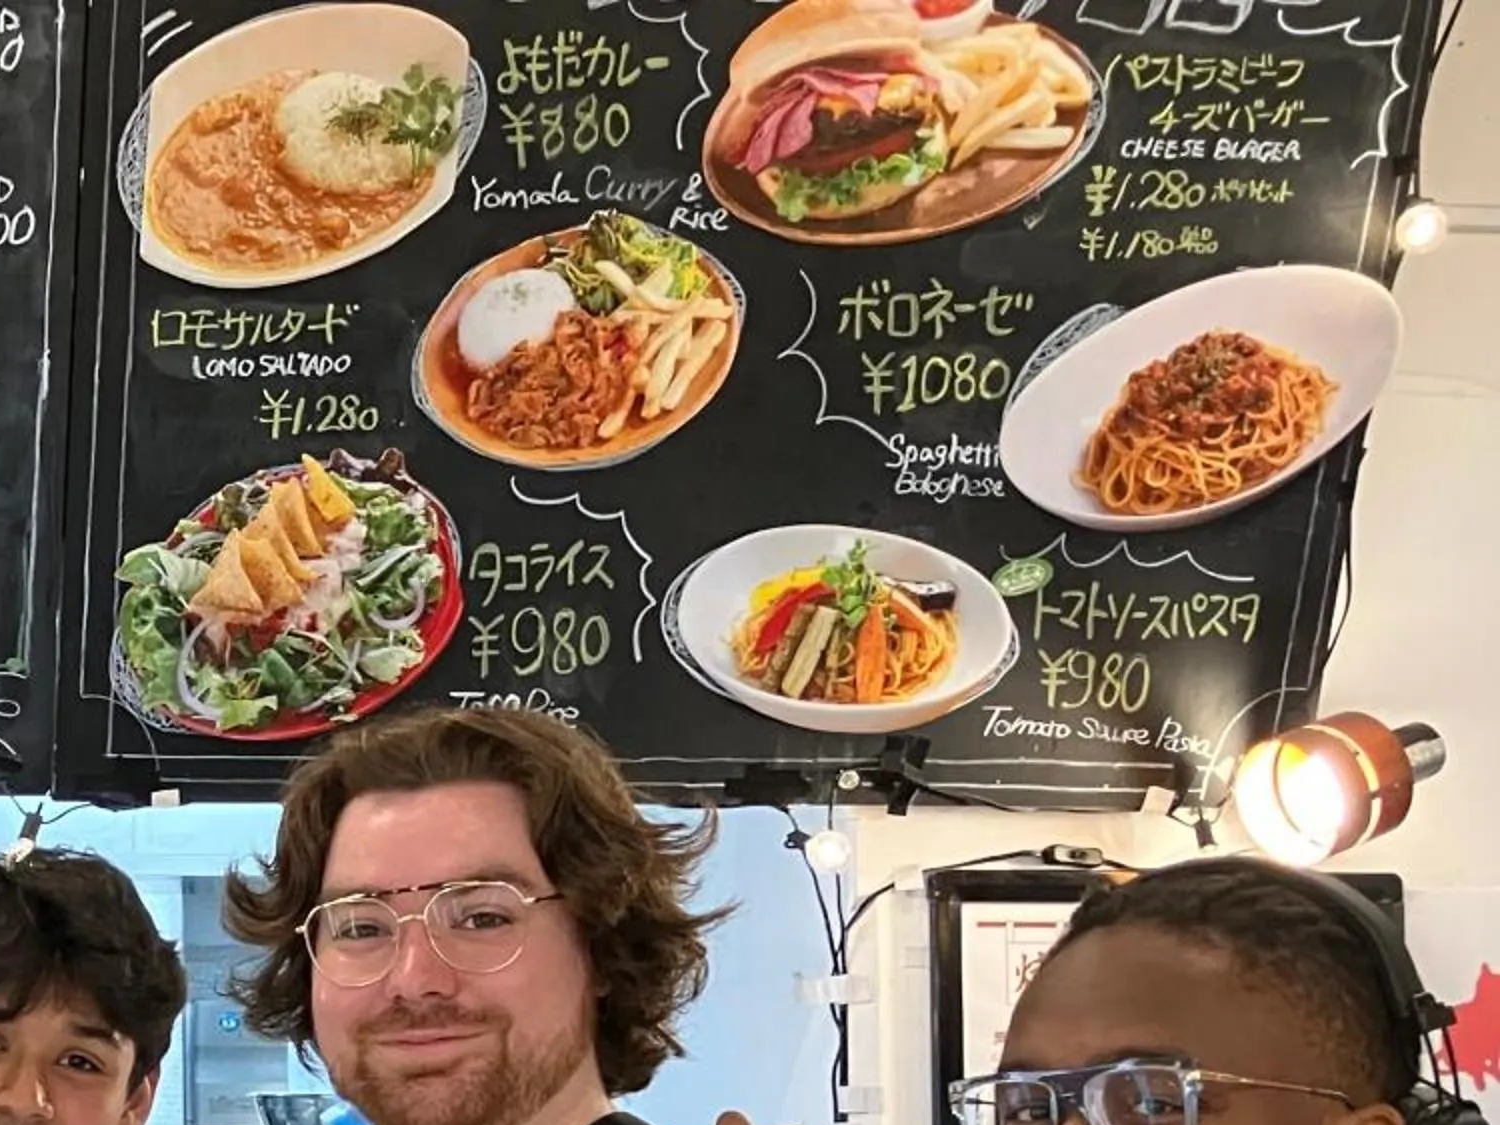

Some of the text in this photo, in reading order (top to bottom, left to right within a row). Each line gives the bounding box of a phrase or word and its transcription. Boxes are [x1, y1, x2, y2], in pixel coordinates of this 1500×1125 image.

[497, 30, 670, 94] よもだカレー
[1103, 53, 1305, 95] パストラミビーフ
[499, 94, 630, 169] ¥880
[1149, 99, 1331, 135] チーズバーガー
[1120, 137, 1301, 163] CHEESE BURGER
[585, 165, 678, 210] Curry
[669, 207, 729, 230] Rice
[152, 303, 361, 350] ロモサルタード
[837, 277, 1034, 340] ボロネーゼ
[192, 353, 352, 380] LOMO SALTADO
[861, 351, 1011, 416] ¥1080
[885, 433, 1001, 472] Spaghetti
[468, 539, 615, 608] タコライス
[1032, 581, 1261, 643] トマトソースパスタ
[467, 606, 611, 679] ¥980
[1038, 648, 1151, 713] ¥980
[982, 706, 1071, 738] Tomato
